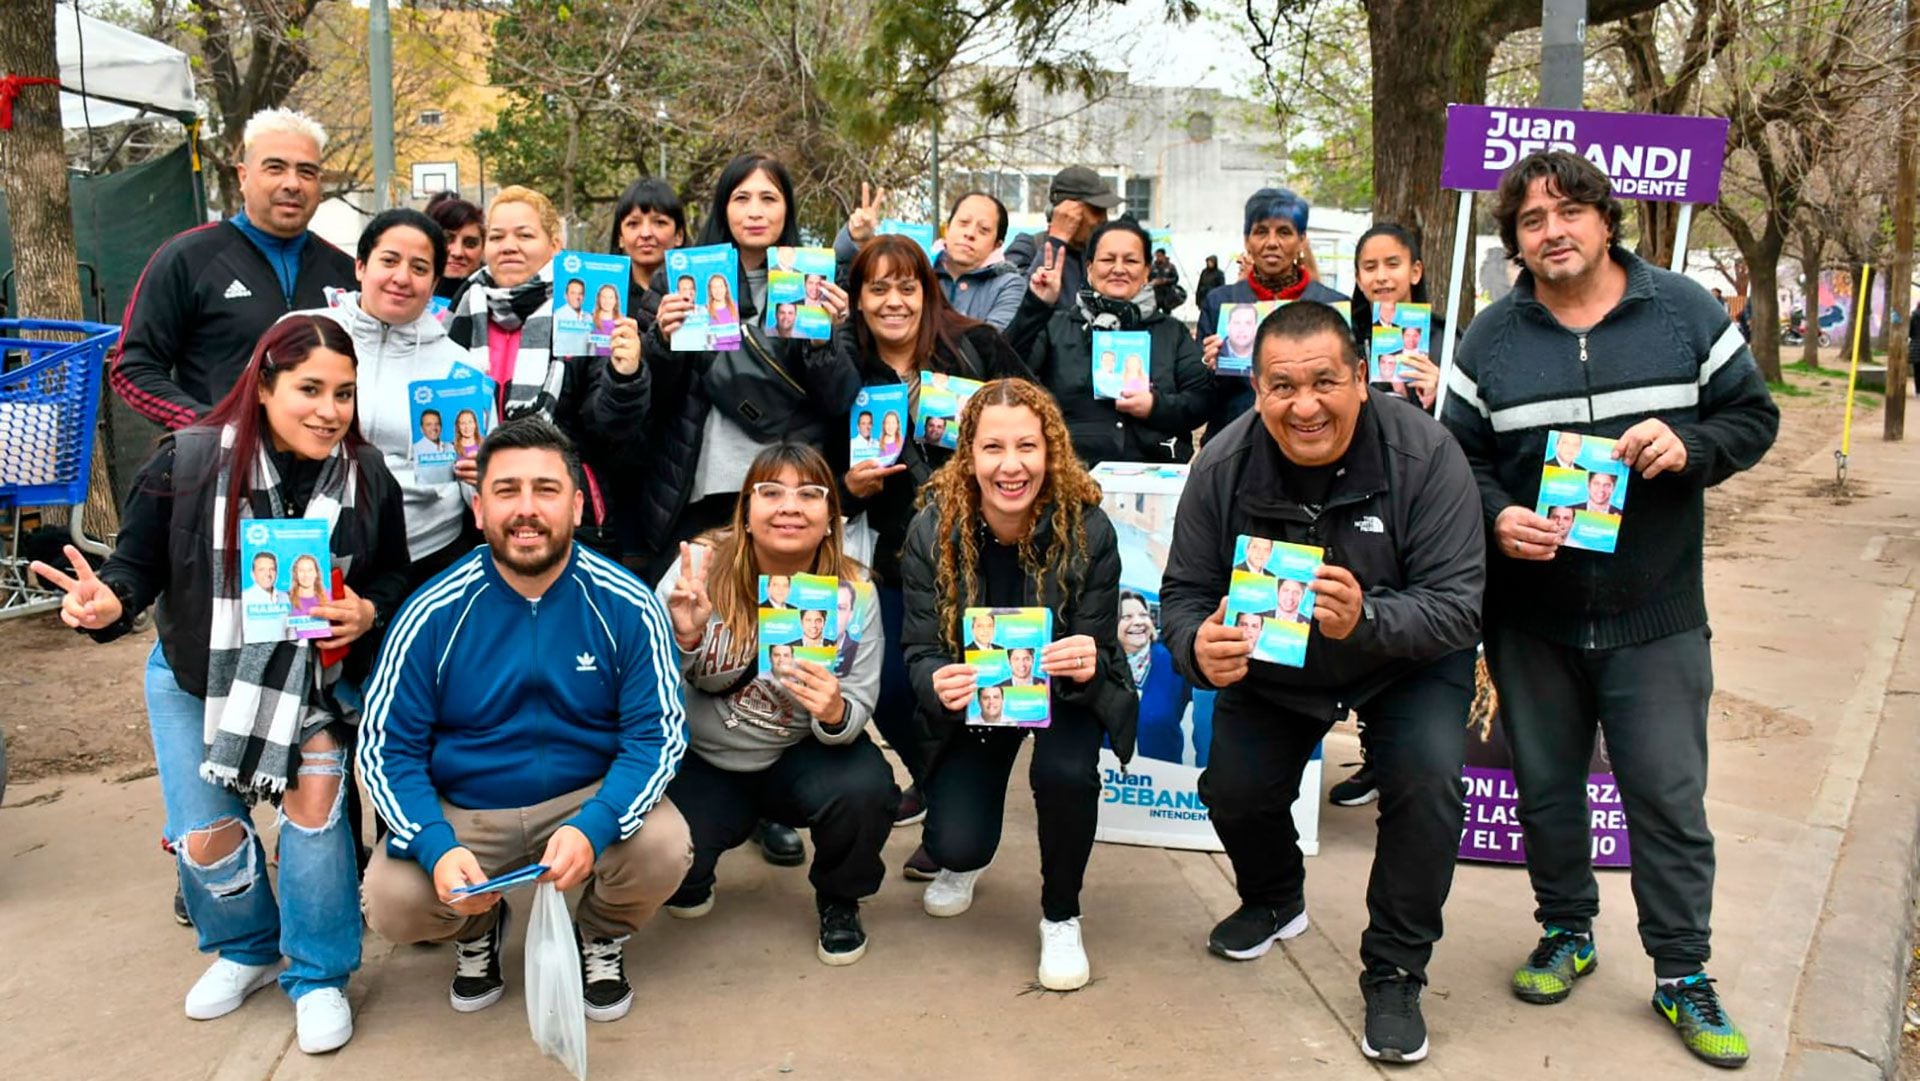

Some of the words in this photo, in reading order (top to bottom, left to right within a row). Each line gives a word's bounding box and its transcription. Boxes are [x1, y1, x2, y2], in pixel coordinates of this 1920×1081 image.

[1486, 111, 1575, 141] Juan
[1610, 177, 1688, 197] NDENTE
[1103, 769, 1152, 787] Juan
[1461, 776, 1493, 797] ON
[1149, 809, 1207, 821] INTENDEN
[1474, 830, 1502, 850] EL
